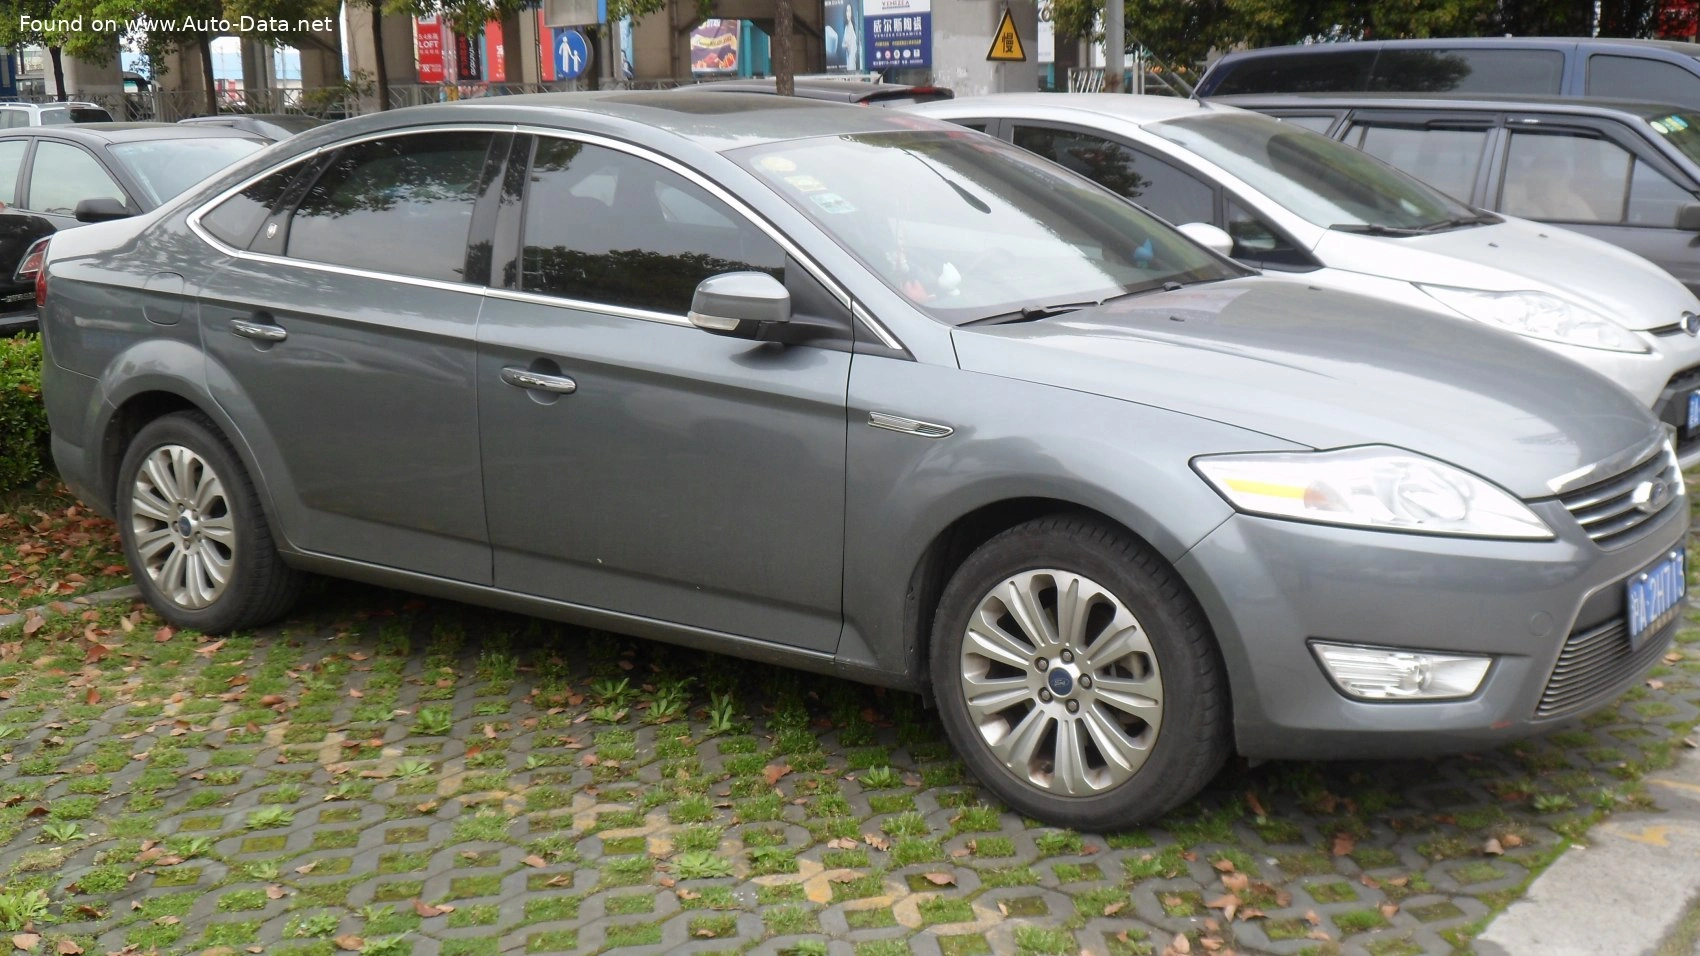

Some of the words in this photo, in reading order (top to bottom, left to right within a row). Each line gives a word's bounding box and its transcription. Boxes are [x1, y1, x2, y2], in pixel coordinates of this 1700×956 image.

[873, 16, 922, 33] 威尔斯陶瓷
[1001, 31, 1015, 54] 慢
